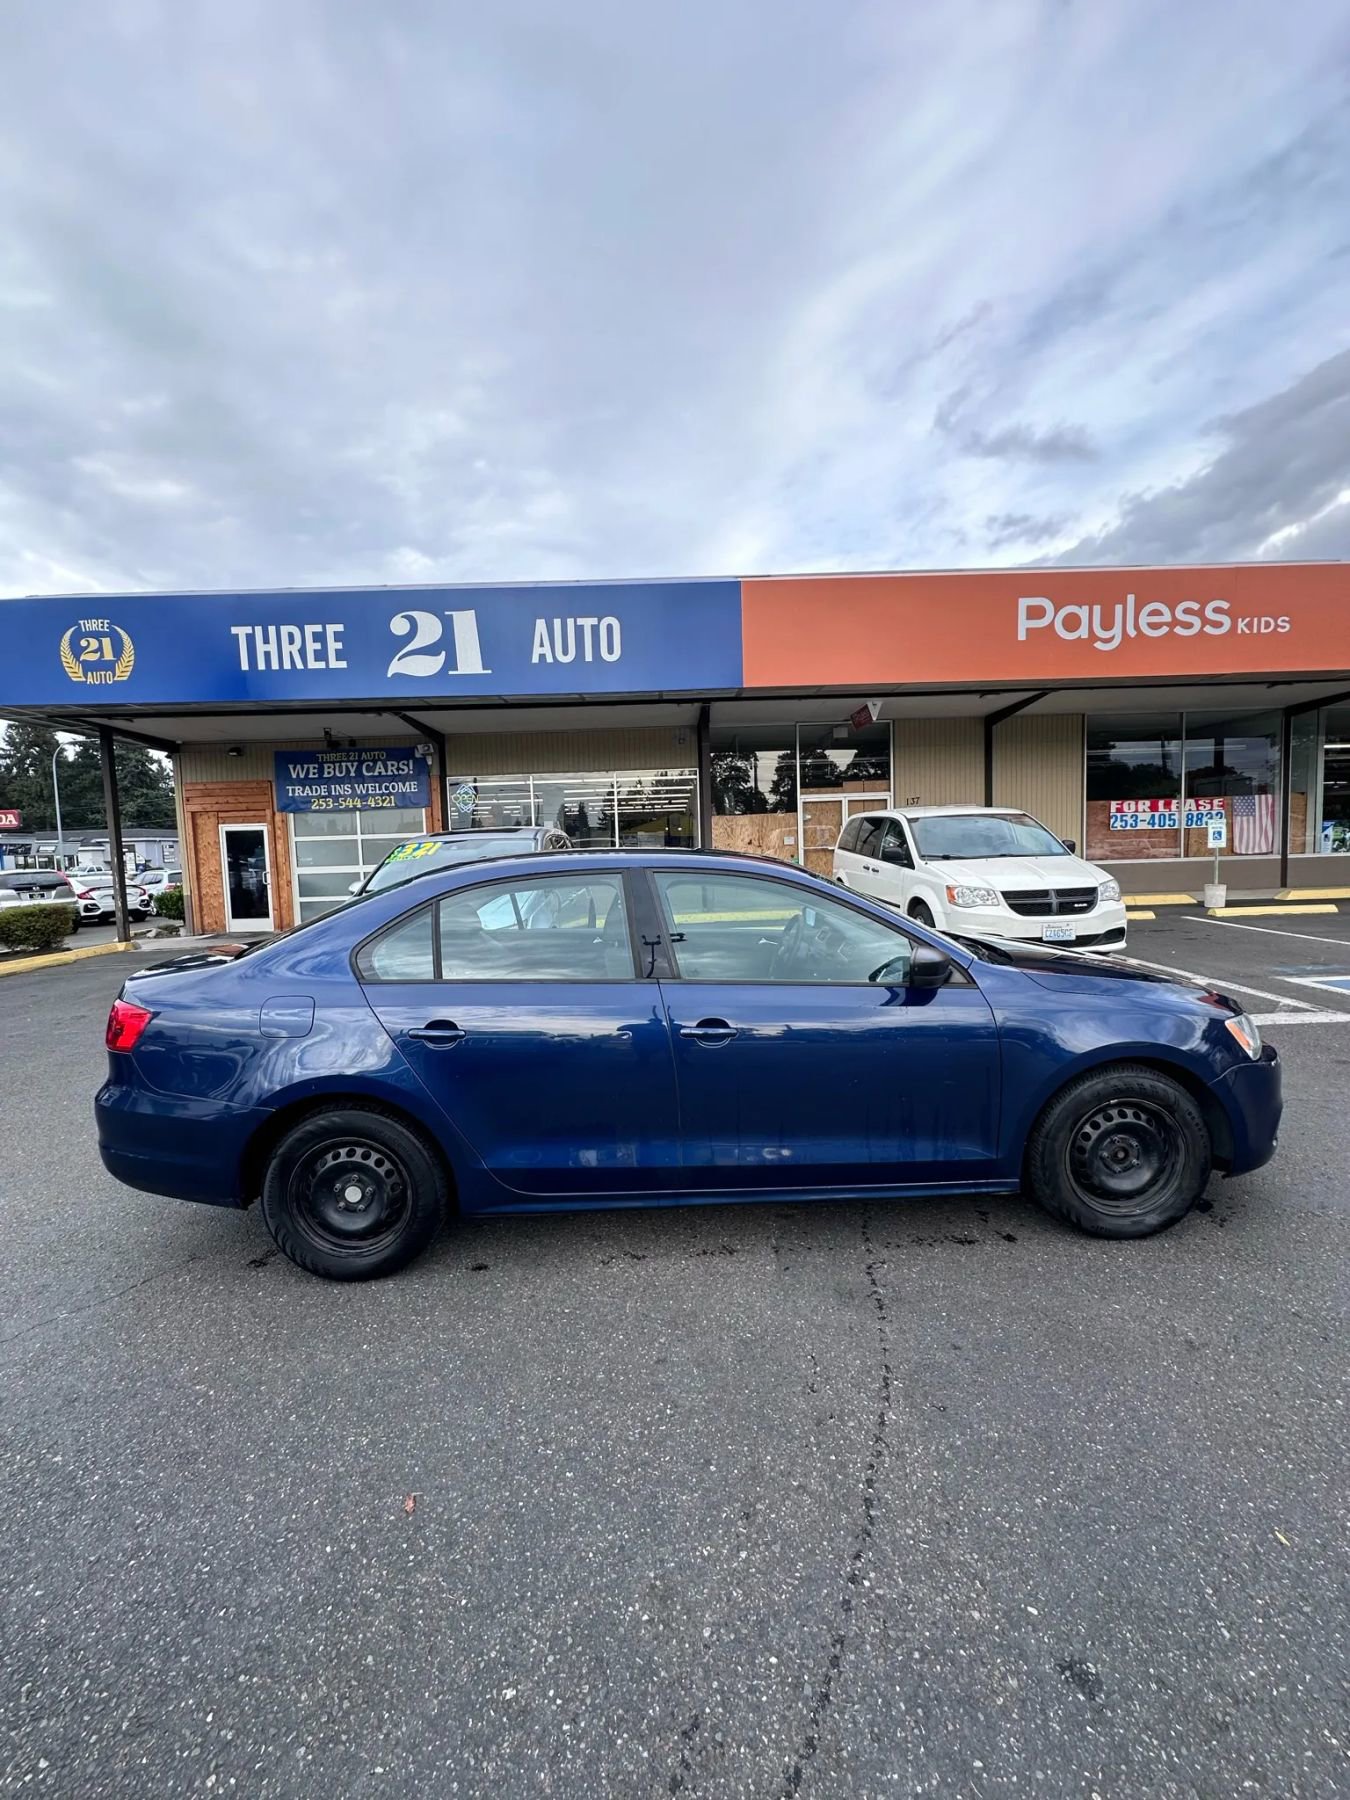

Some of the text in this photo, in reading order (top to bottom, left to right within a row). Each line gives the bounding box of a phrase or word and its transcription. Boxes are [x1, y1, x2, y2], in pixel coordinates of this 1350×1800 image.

[78, 619, 111, 632] THREE
[1017, 594, 1291, 651] Payless KIDS
[80, 637, 117, 661] 21
[230, 609, 622, 678] THREE 21 AUTO
[86, 671, 114, 685] AUTO
[316, 751, 386, 762] THREE 21 AUTO
[288, 759, 414, 778] WE BUY CARS!
[286, 781, 418, 797] TRADE INS WELCOME
[311, 796, 396, 810] 253-544-4321
[451, 794, 479, 804] OPEN
[1110, 798, 1225, 812] FOR LEASE
